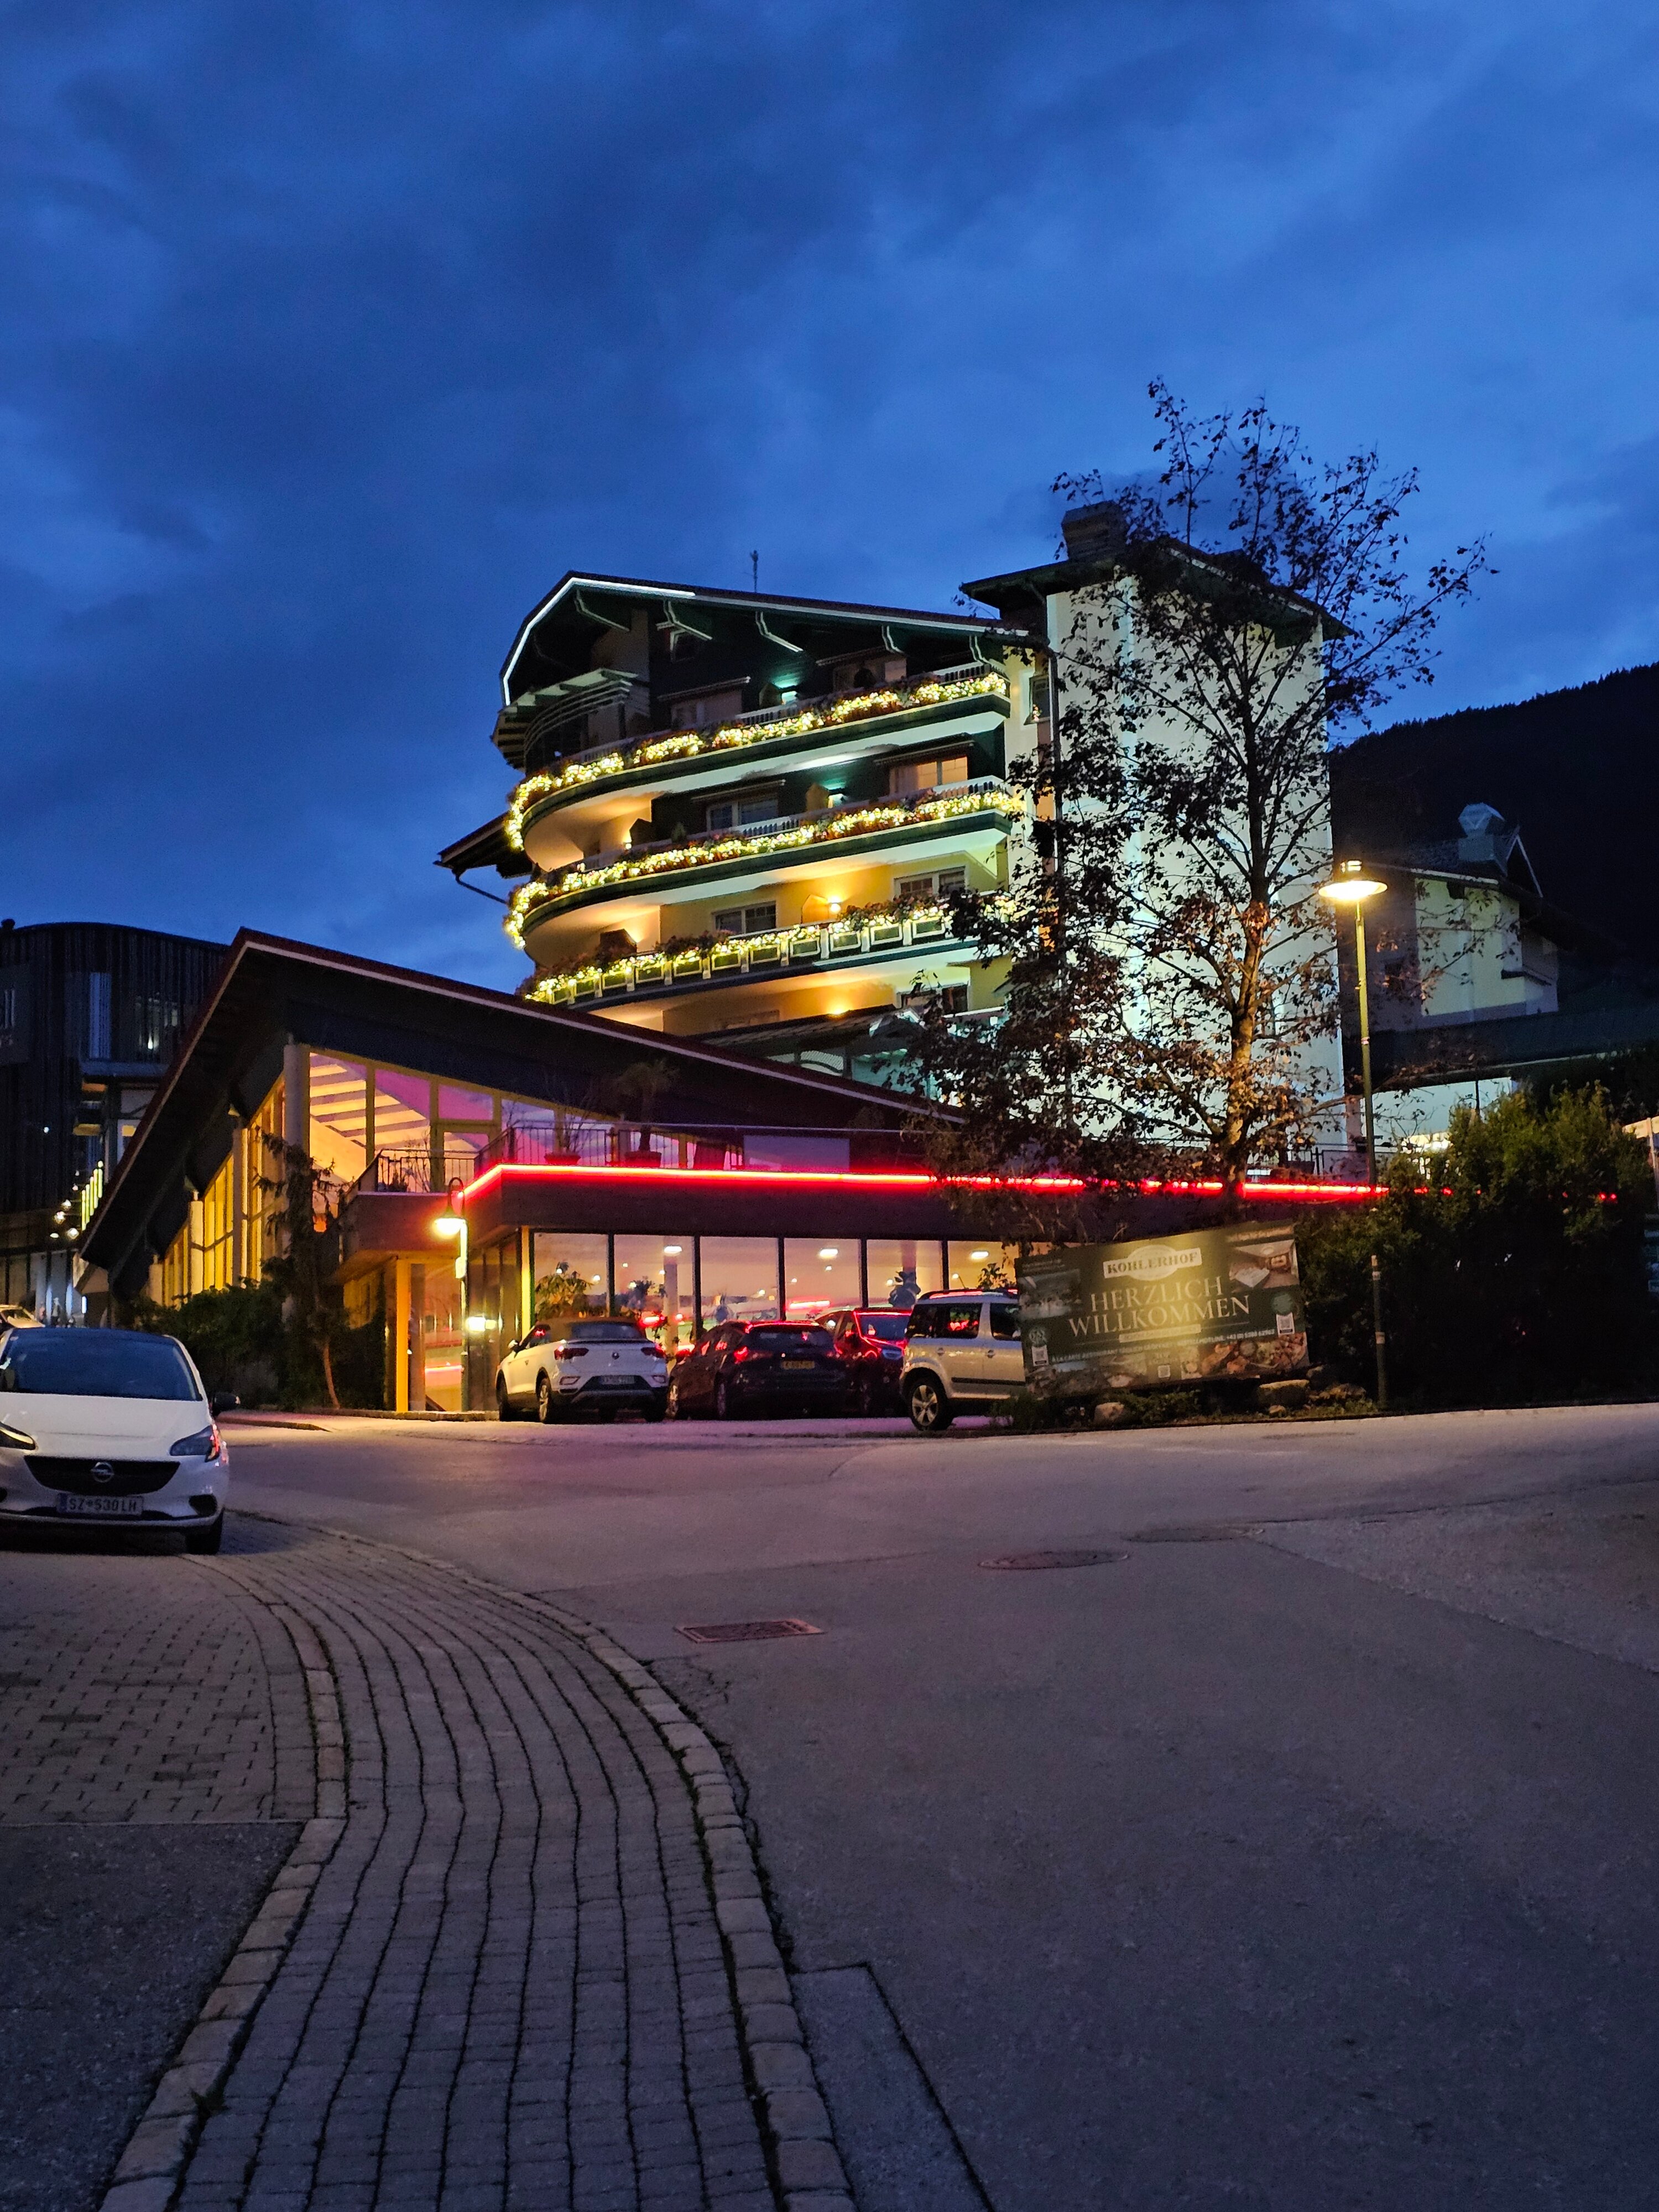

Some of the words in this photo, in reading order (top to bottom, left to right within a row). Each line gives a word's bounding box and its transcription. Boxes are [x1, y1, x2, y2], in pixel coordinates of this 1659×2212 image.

[1107, 1251, 1198, 1274] KOHLERHOF
[1091, 1276, 1223, 1312] HERZLICH
[1068, 1295, 1249, 1337] WILLKOMMEN
[69, 1498, 85, 1510] SZ
